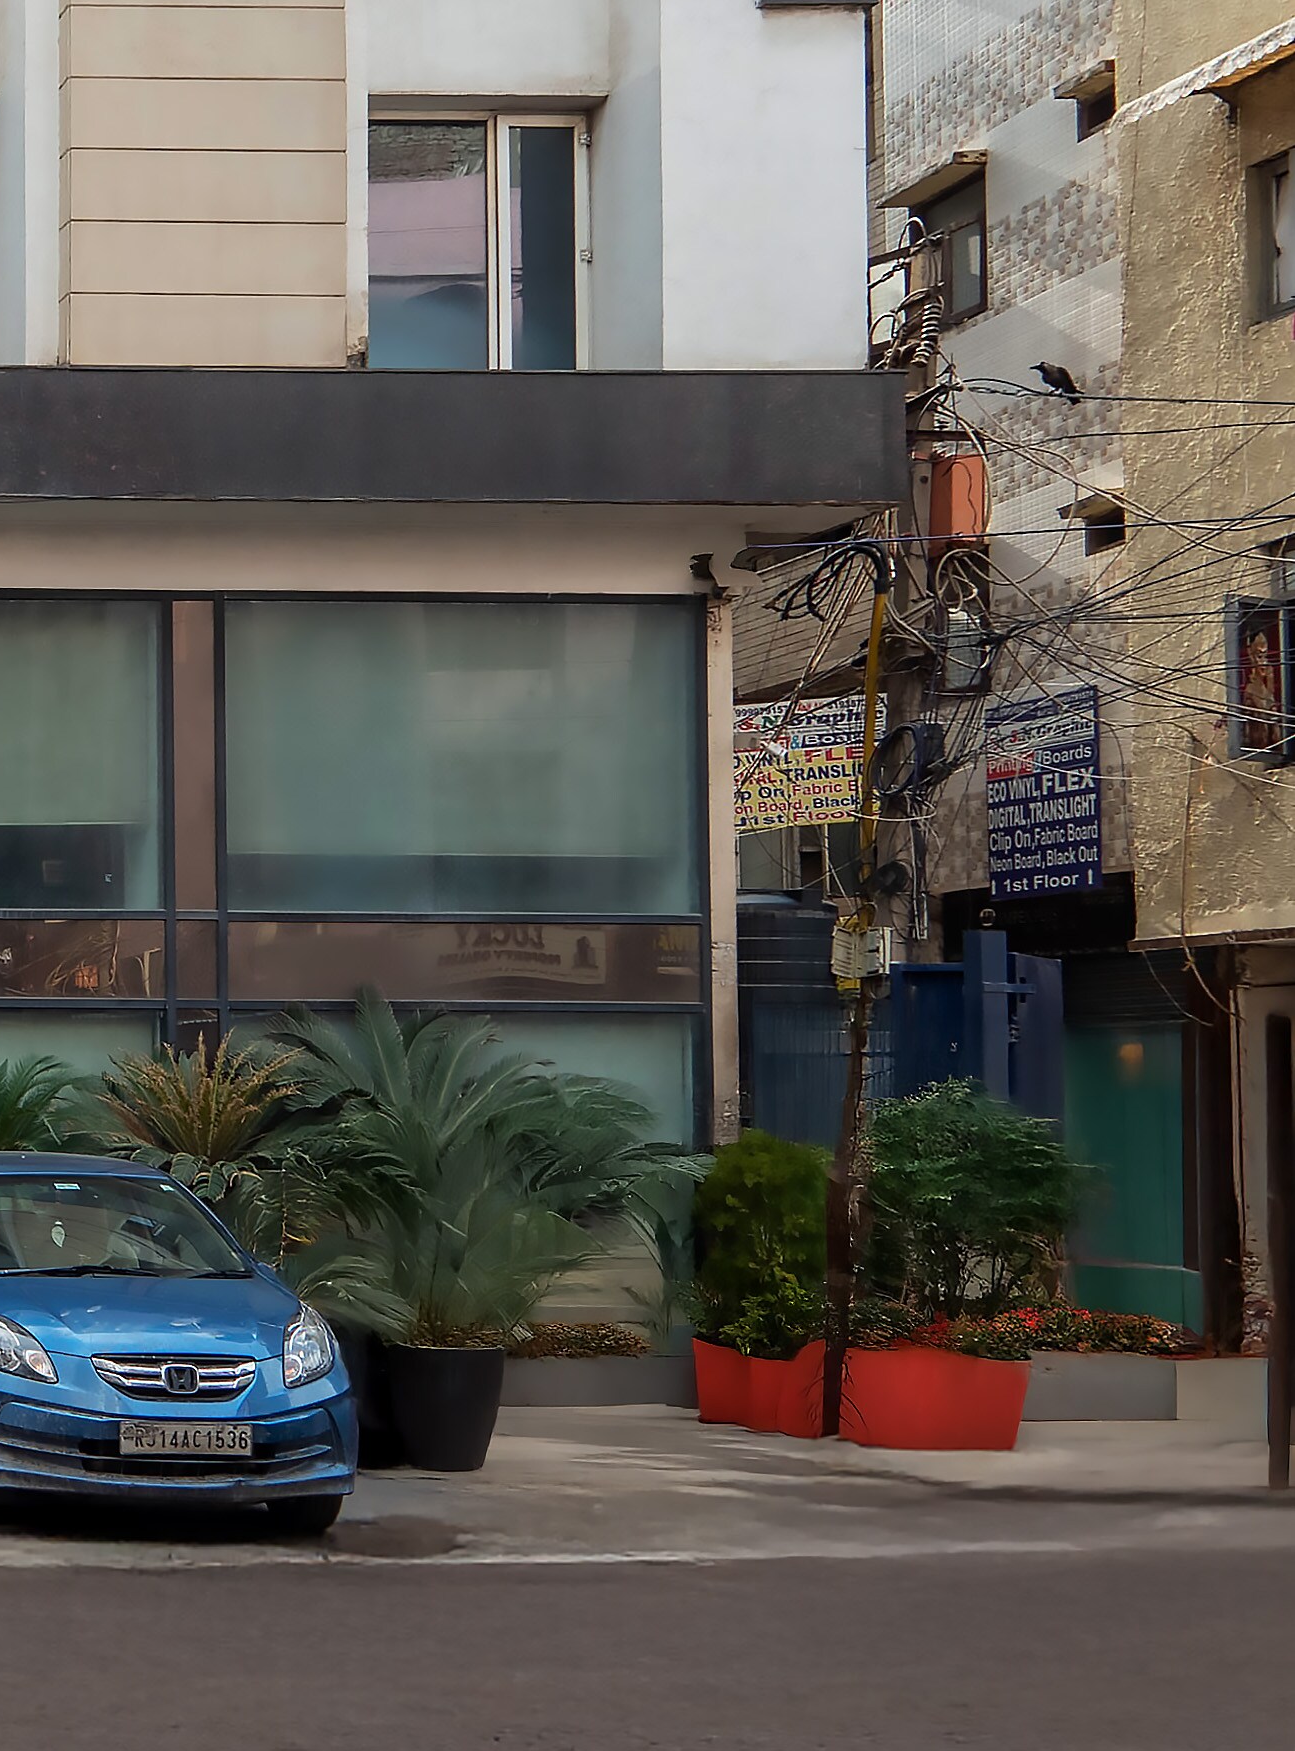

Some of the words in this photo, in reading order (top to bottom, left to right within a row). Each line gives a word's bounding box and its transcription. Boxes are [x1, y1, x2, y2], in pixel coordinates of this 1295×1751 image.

[804, 747, 864, 763] FLE
[1042, 744, 1092, 765] Boards
[1042, 766, 1096, 796] FLEX
[990, 831, 1011, 854] Clip
[1067, 820, 1098, 842] Board
[990, 856, 1013, 873] Neon
[1046, 847, 1076, 866] Black
[1078, 845, 1098, 862] Out
[1003, 877, 1029, 893] 1st
[1033, 874, 1080, 890] Floor
